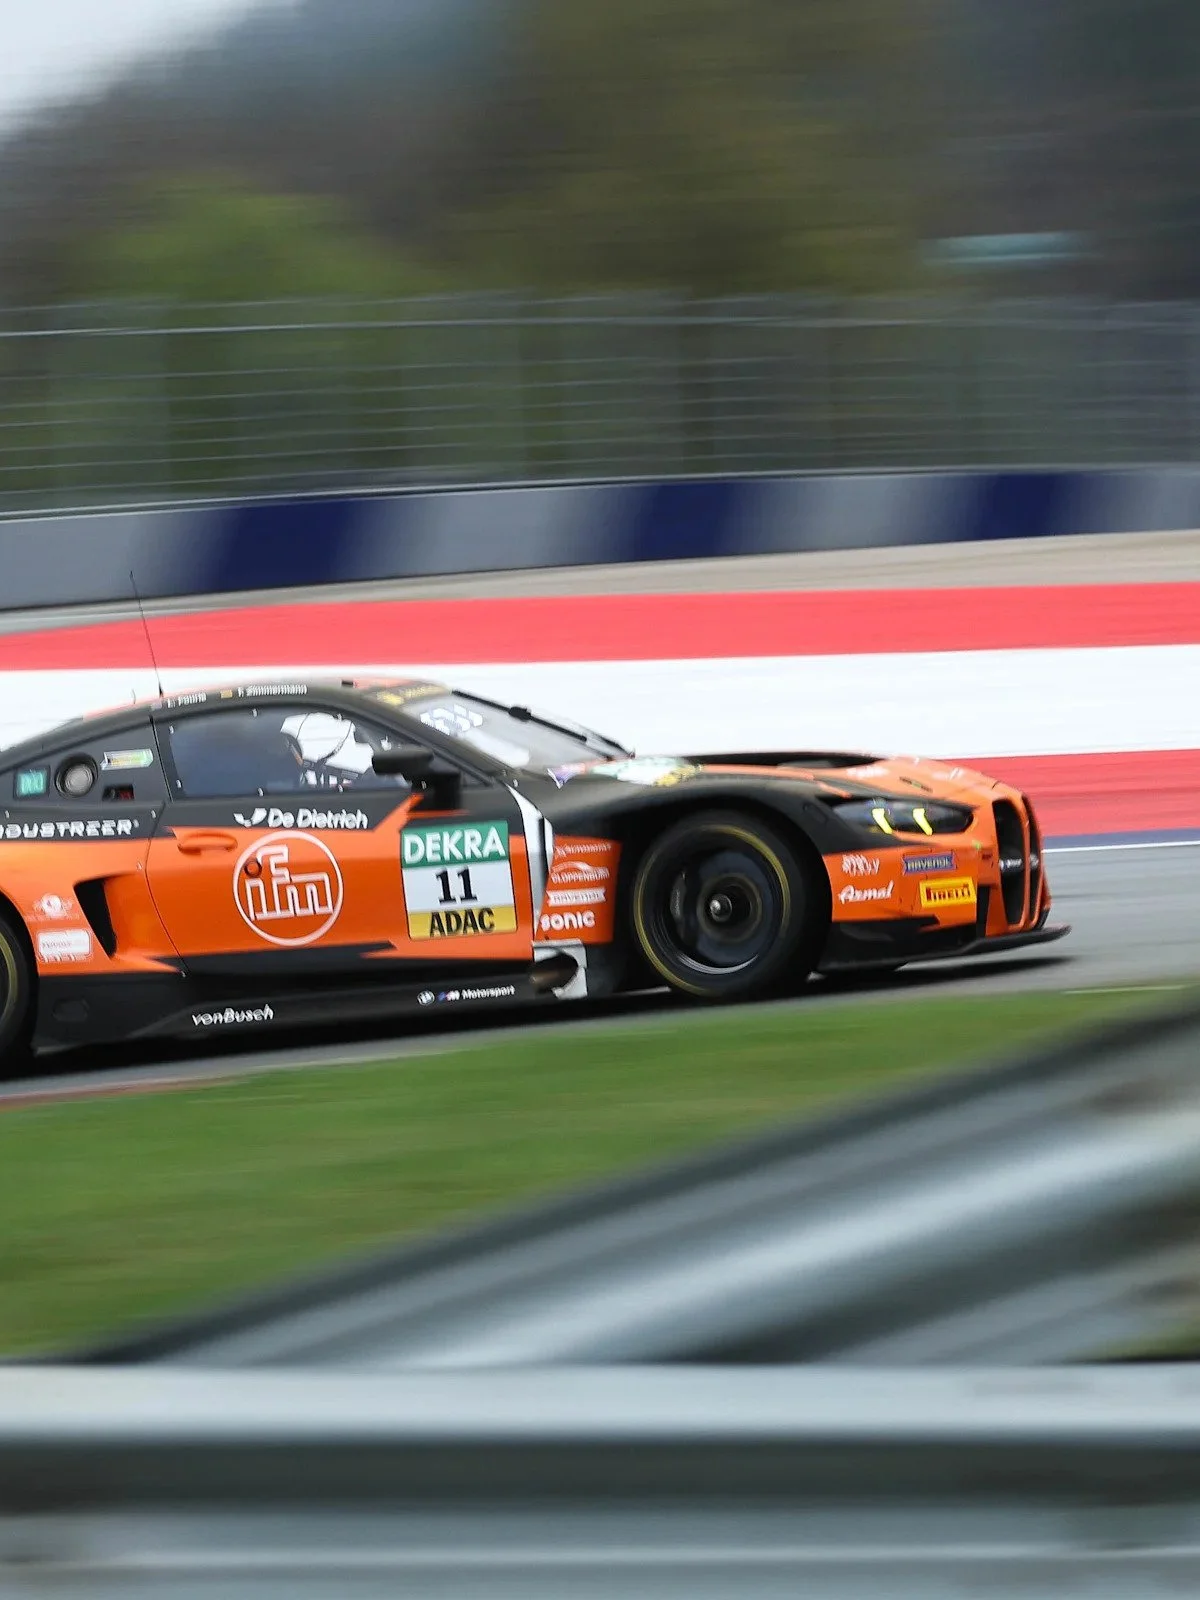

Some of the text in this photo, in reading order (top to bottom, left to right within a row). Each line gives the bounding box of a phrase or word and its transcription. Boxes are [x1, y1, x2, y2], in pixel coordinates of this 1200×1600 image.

[268, 808, 368, 829] De Dietrich
[403, 826, 506, 864] DEKRA
[435, 866, 478, 904] 11
[429, 907, 495, 938] ADAC
[540, 909, 596, 932] sonic
[461, 985, 516, 1000] Motorsport
[191, 1003, 274, 1026] vonBusch
